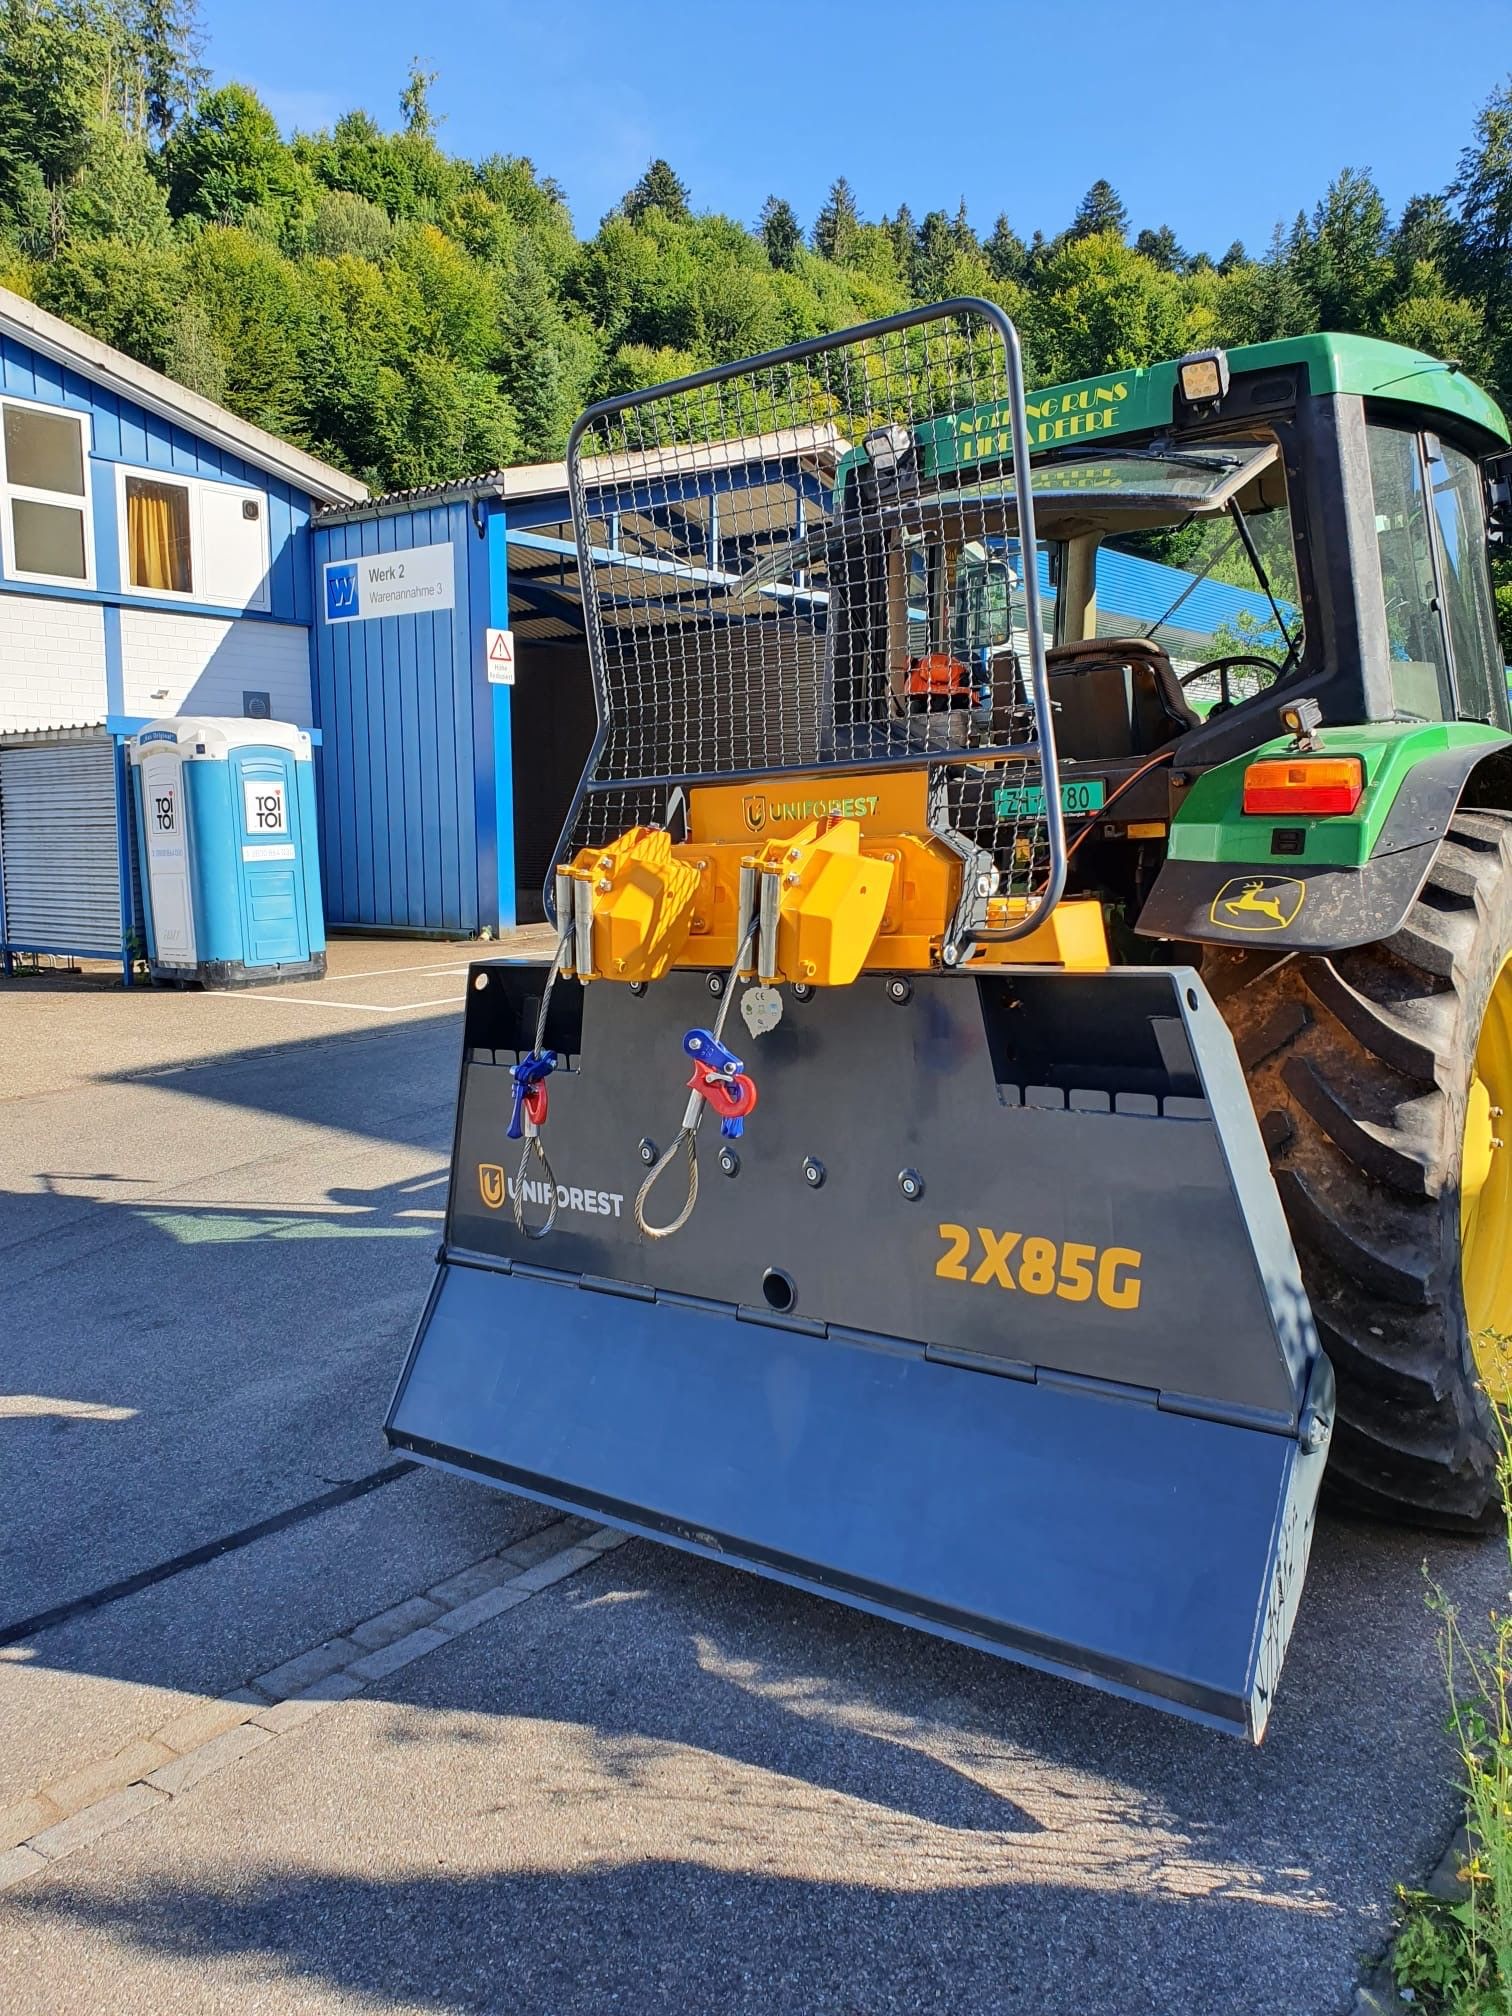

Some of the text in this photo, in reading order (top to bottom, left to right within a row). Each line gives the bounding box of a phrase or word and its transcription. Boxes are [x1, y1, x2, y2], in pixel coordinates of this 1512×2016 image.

[959, 382, 1128, 435] NOTNG RUNS
[963, 431, 1013, 460] LIKE
[1038, 407, 1120, 443] DEERE
[369, 564, 405, 583] Werk 2
[369, 582, 443, 604] Warenannahme 3
[157, 814, 174, 830] TOI
[256, 812, 282, 828] TOI
[769, 796, 879, 822] UNIFOREST
[507, 1177, 624, 1217] UNIFOREST
[936, 1224, 1141, 1309] 2X85G
